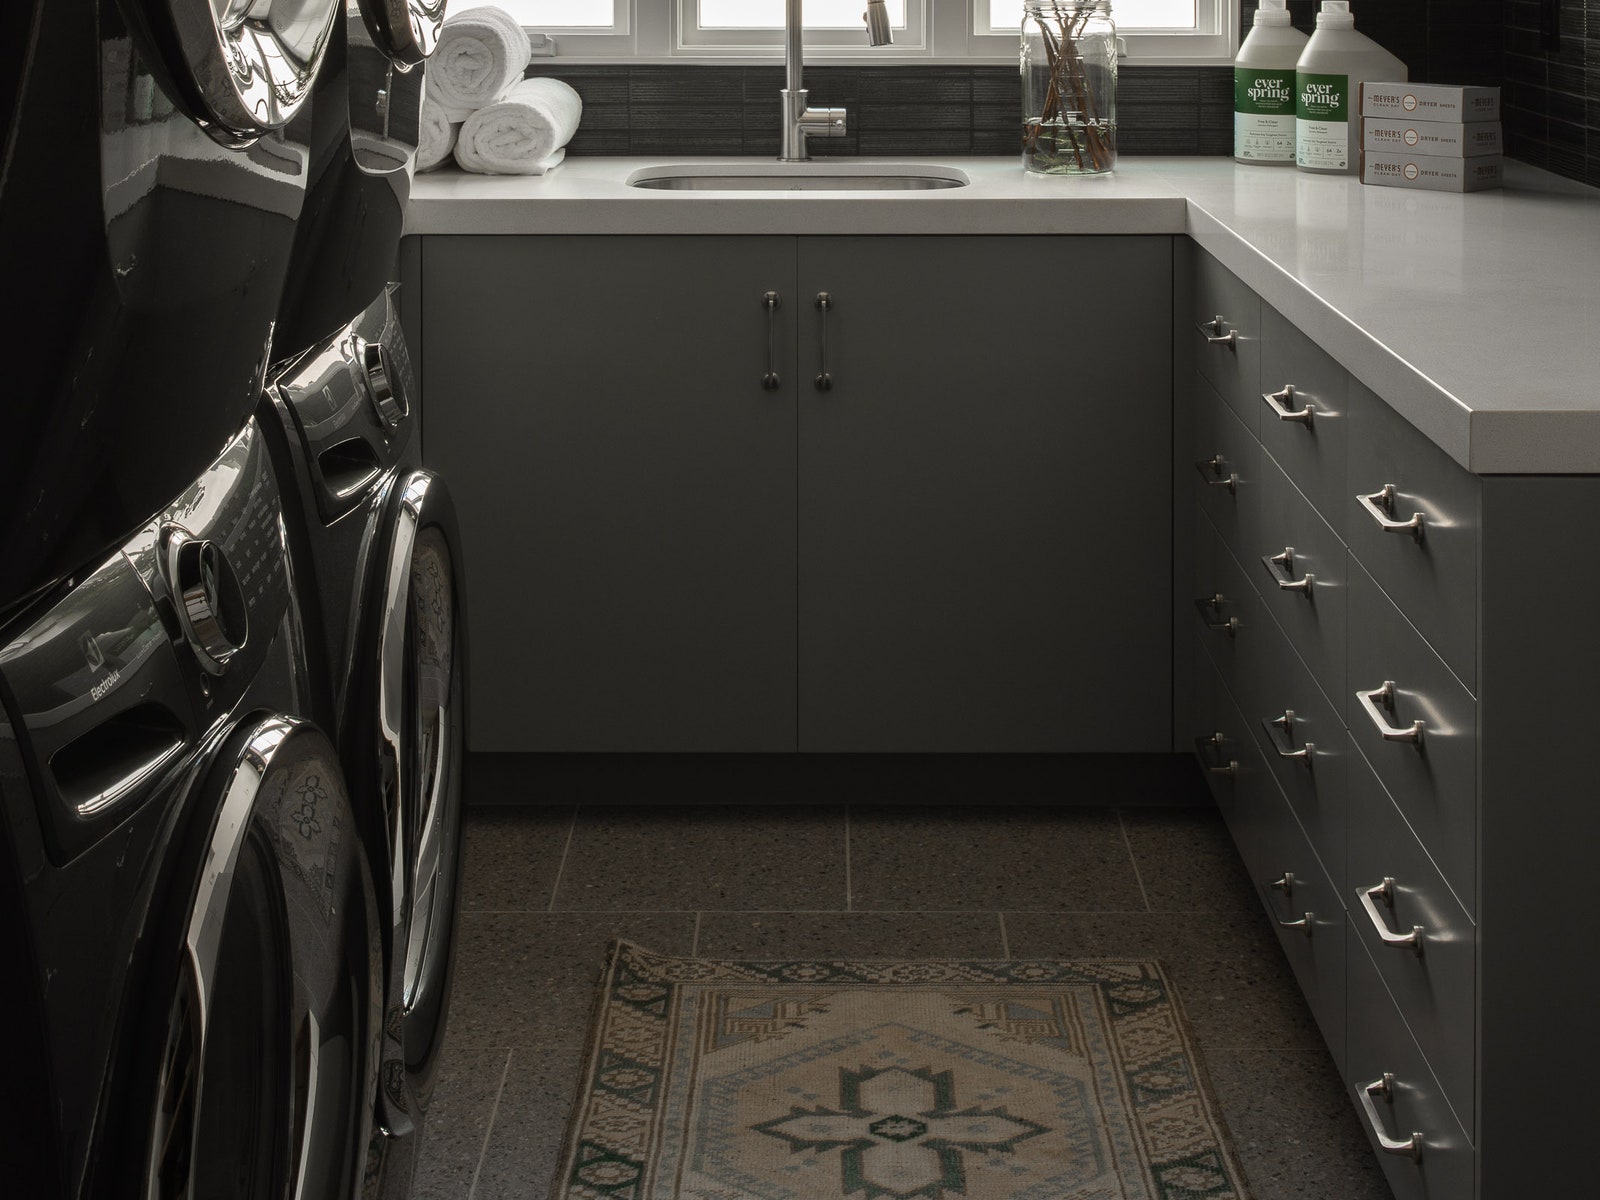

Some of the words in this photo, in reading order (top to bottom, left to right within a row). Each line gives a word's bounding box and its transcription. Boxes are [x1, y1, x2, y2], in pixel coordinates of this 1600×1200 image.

[1254, 78, 1283, 88] ever
[1306, 83, 1333, 94] ever
[1247, 86, 1290, 102] spring
[1301, 92, 1340, 108] spring
[91, 669, 121, 701] Electrolux
